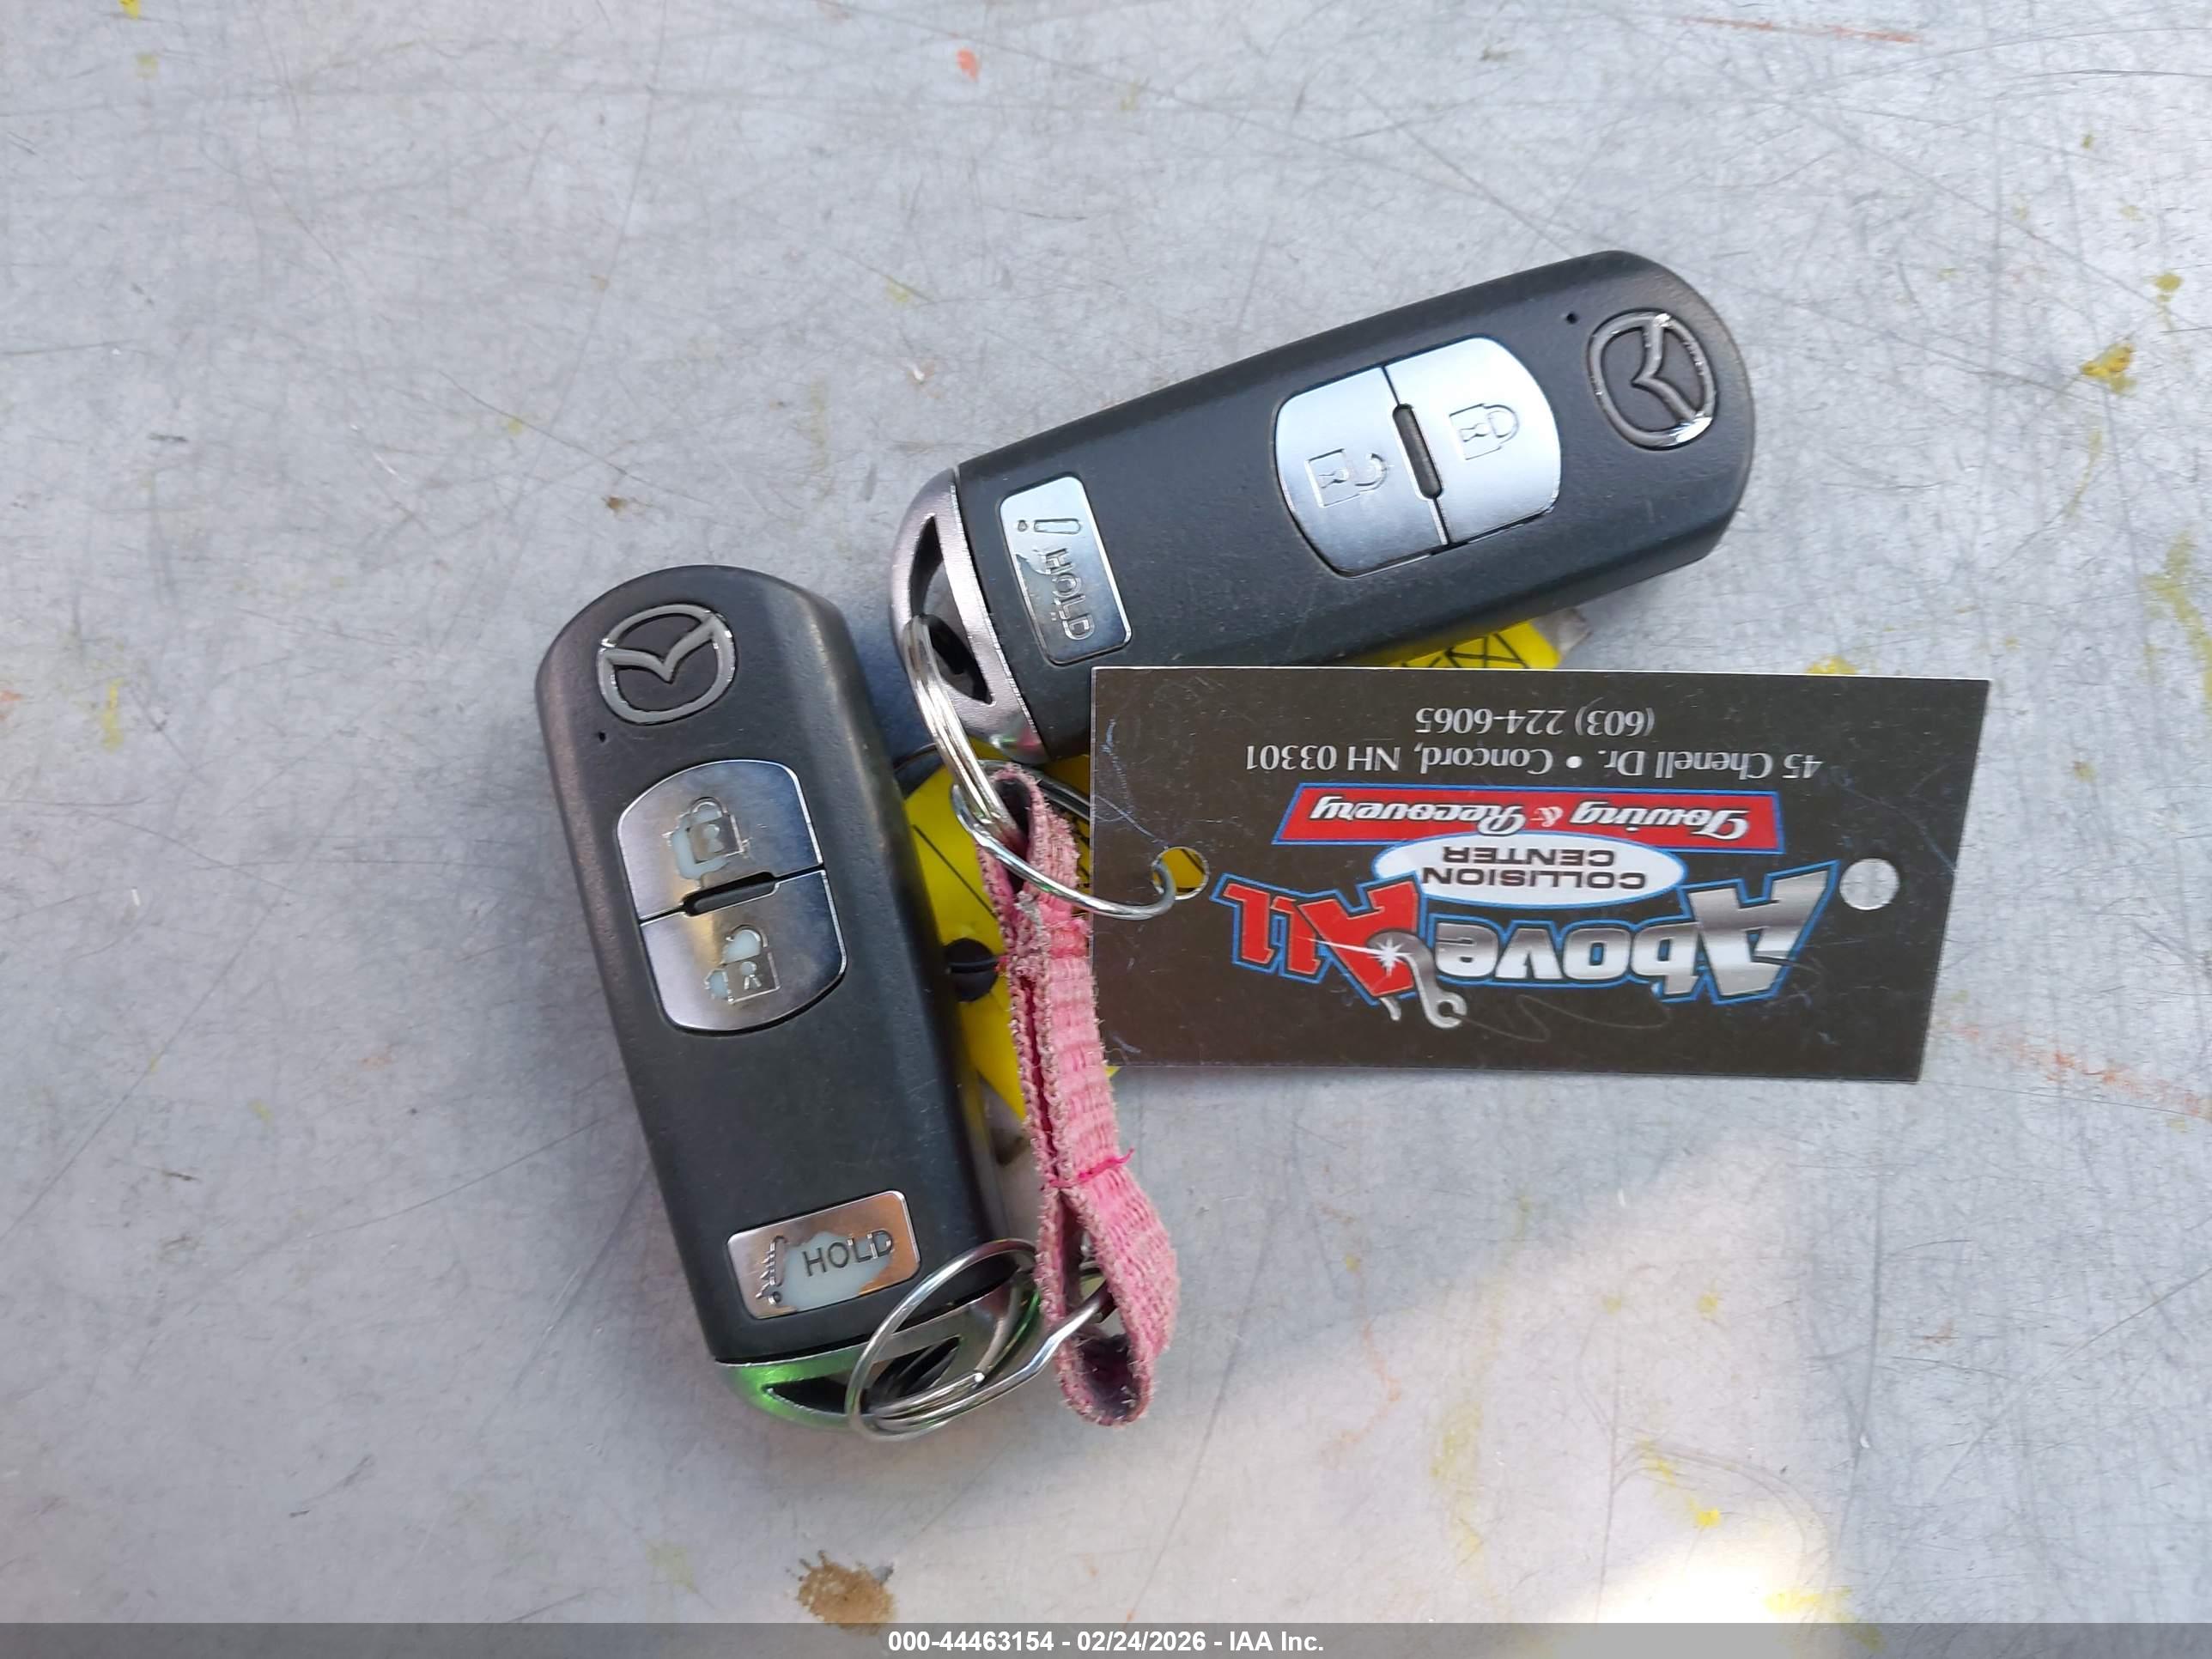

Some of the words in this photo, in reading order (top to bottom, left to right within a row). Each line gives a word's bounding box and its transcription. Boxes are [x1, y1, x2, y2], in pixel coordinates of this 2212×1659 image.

[1044, 548, 1095, 641] HOLD
[1415, 707, 1564, 736] 224-6065
[1574, 706, 1656, 738] (603)
[1246, 744, 1338, 771] 03301
[1347, 744, 1401, 773] NH
[1413, 743, 1553, 775] Concord,
[1597, 749, 1646, 777] Dr.
[1655, 750, 1772, 781] Chenell
[1783, 753, 1824, 780] 45
[1309, 795, 1527, 836] Recovery
[1531, 806, 1564, 829] &
[1570, 799, 1750, 841] Towing
[1443, 846, 1615, 867] CENTER
[1422, 866, 1646, 890] COLLISION
[1434, 867, 1834, 1000] Above
[802, 1229, 893, 1277] HOLD
